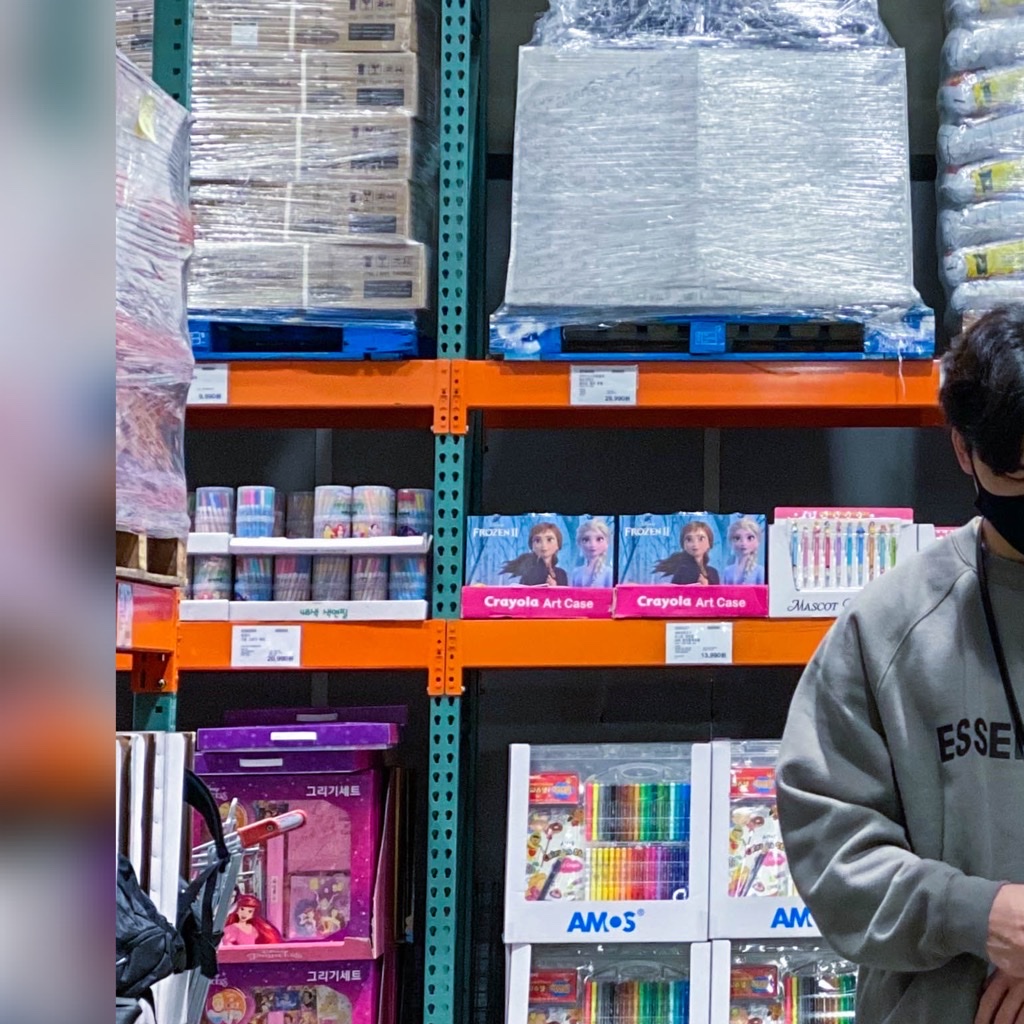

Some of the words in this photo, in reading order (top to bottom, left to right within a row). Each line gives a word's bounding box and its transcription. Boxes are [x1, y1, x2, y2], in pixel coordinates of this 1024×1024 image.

[473, 528, 510, 538] FROZEN
[624, 526, 661, 537] FROZEN
[484, 595, 539, 608] Crayola
[543, 598, 562, 608] Art
[564, 598, 594, 609] Case
[637, 595, 692, 608] Crayola
[695, 597, 714, 608] Art
[716, 597, 746, 608] Case
[787, 599, 839, 612] MASCOT
[306, 785, 360, 797] 그리기세트
[306, 969, 362, 983] 그리기세트
